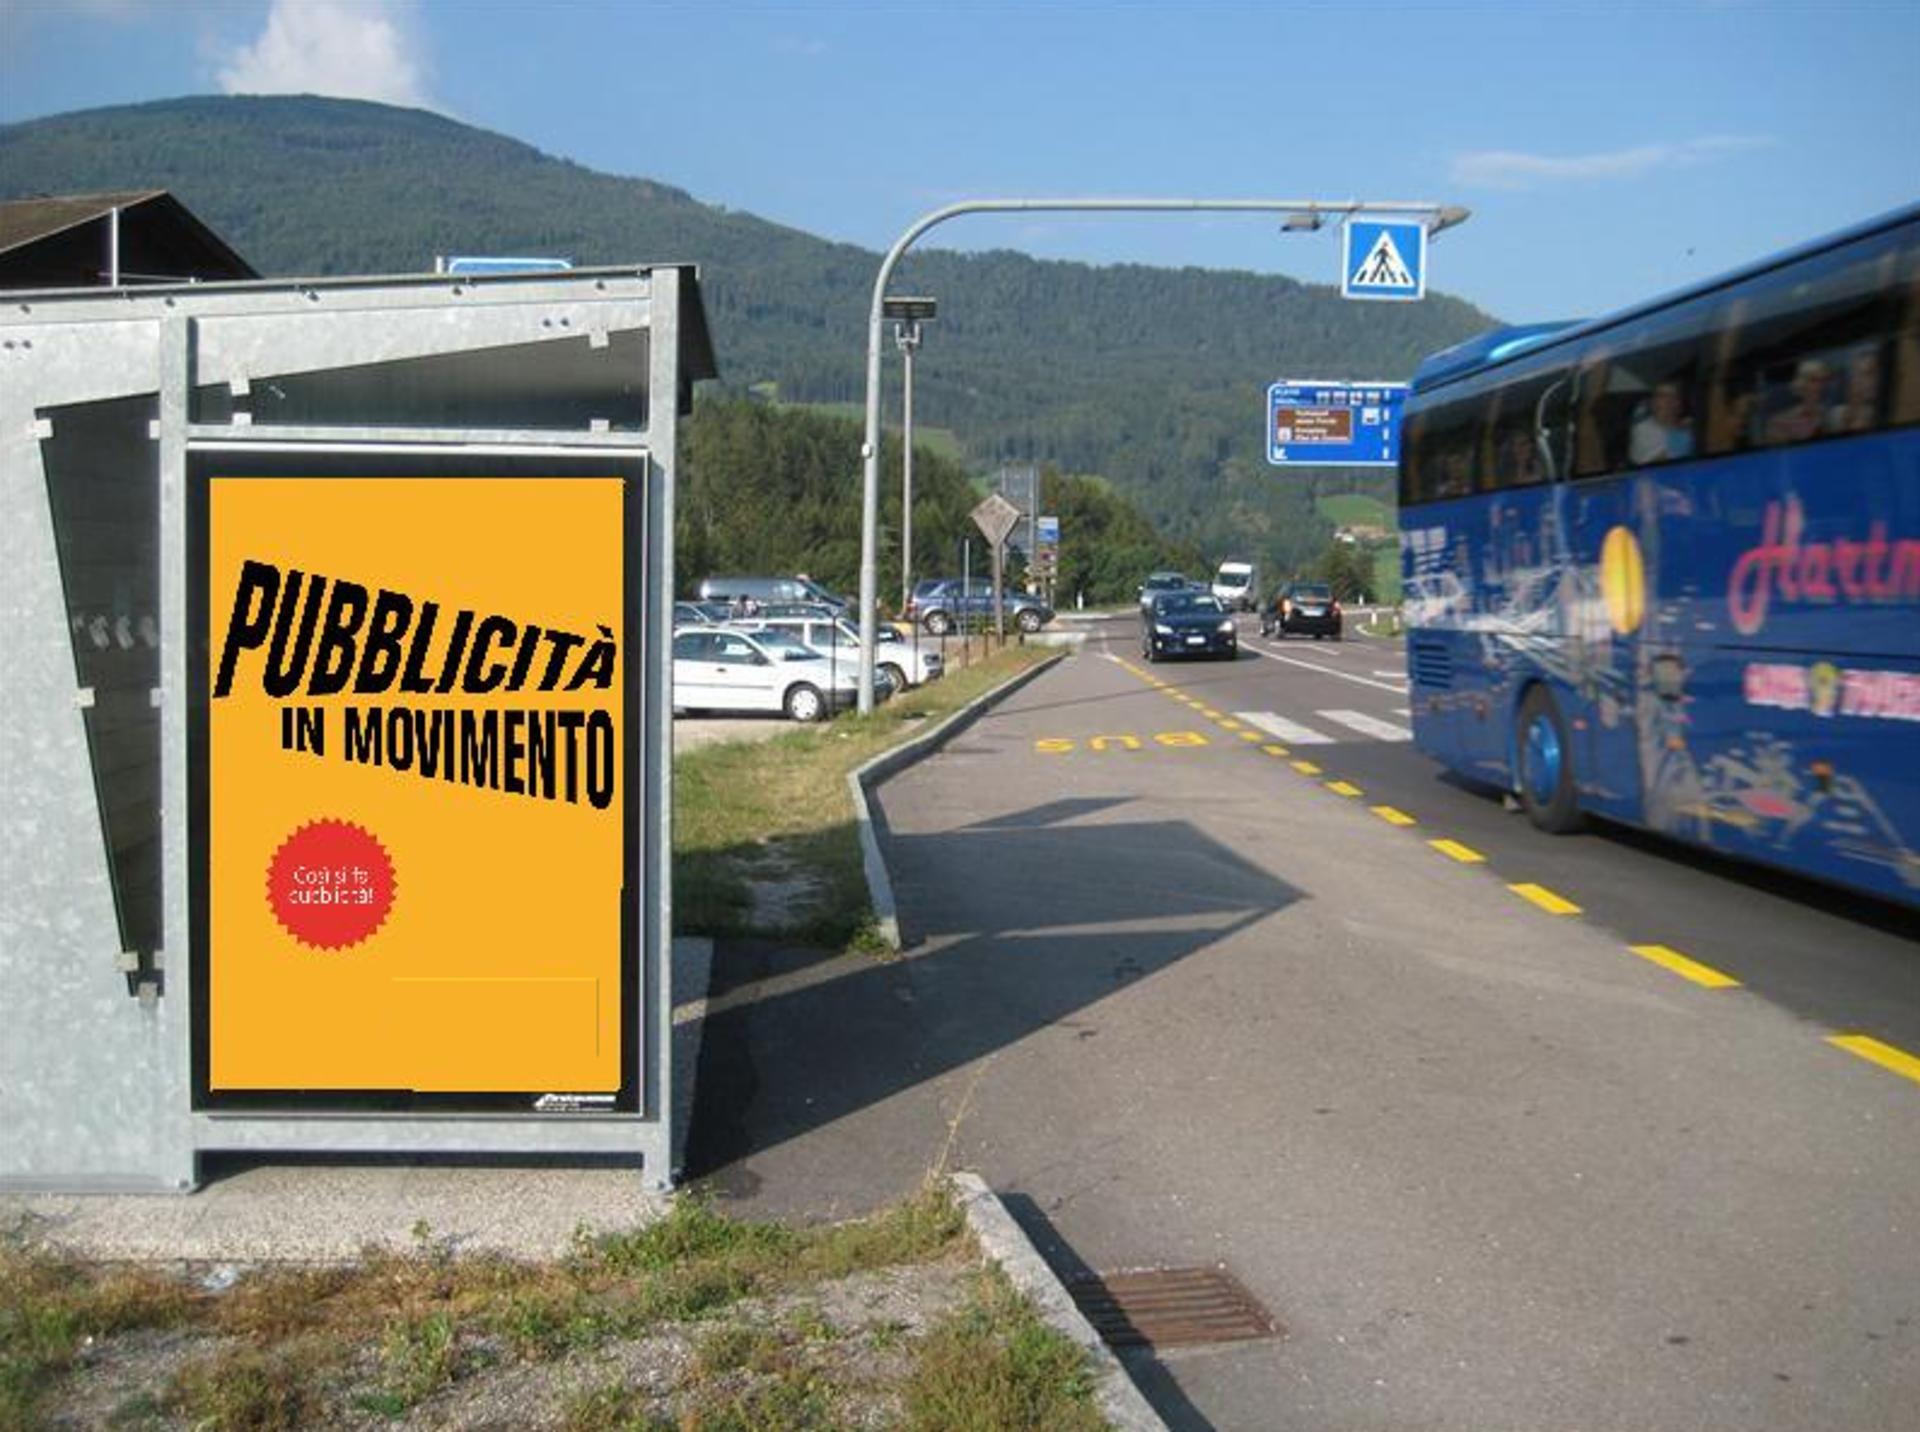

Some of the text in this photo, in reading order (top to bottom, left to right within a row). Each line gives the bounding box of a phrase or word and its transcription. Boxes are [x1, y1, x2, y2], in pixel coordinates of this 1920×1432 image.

[213, 559, 617, 699] PUBBLICITÀ
[281, 707, 614, 810] IN MOVIMENTO
